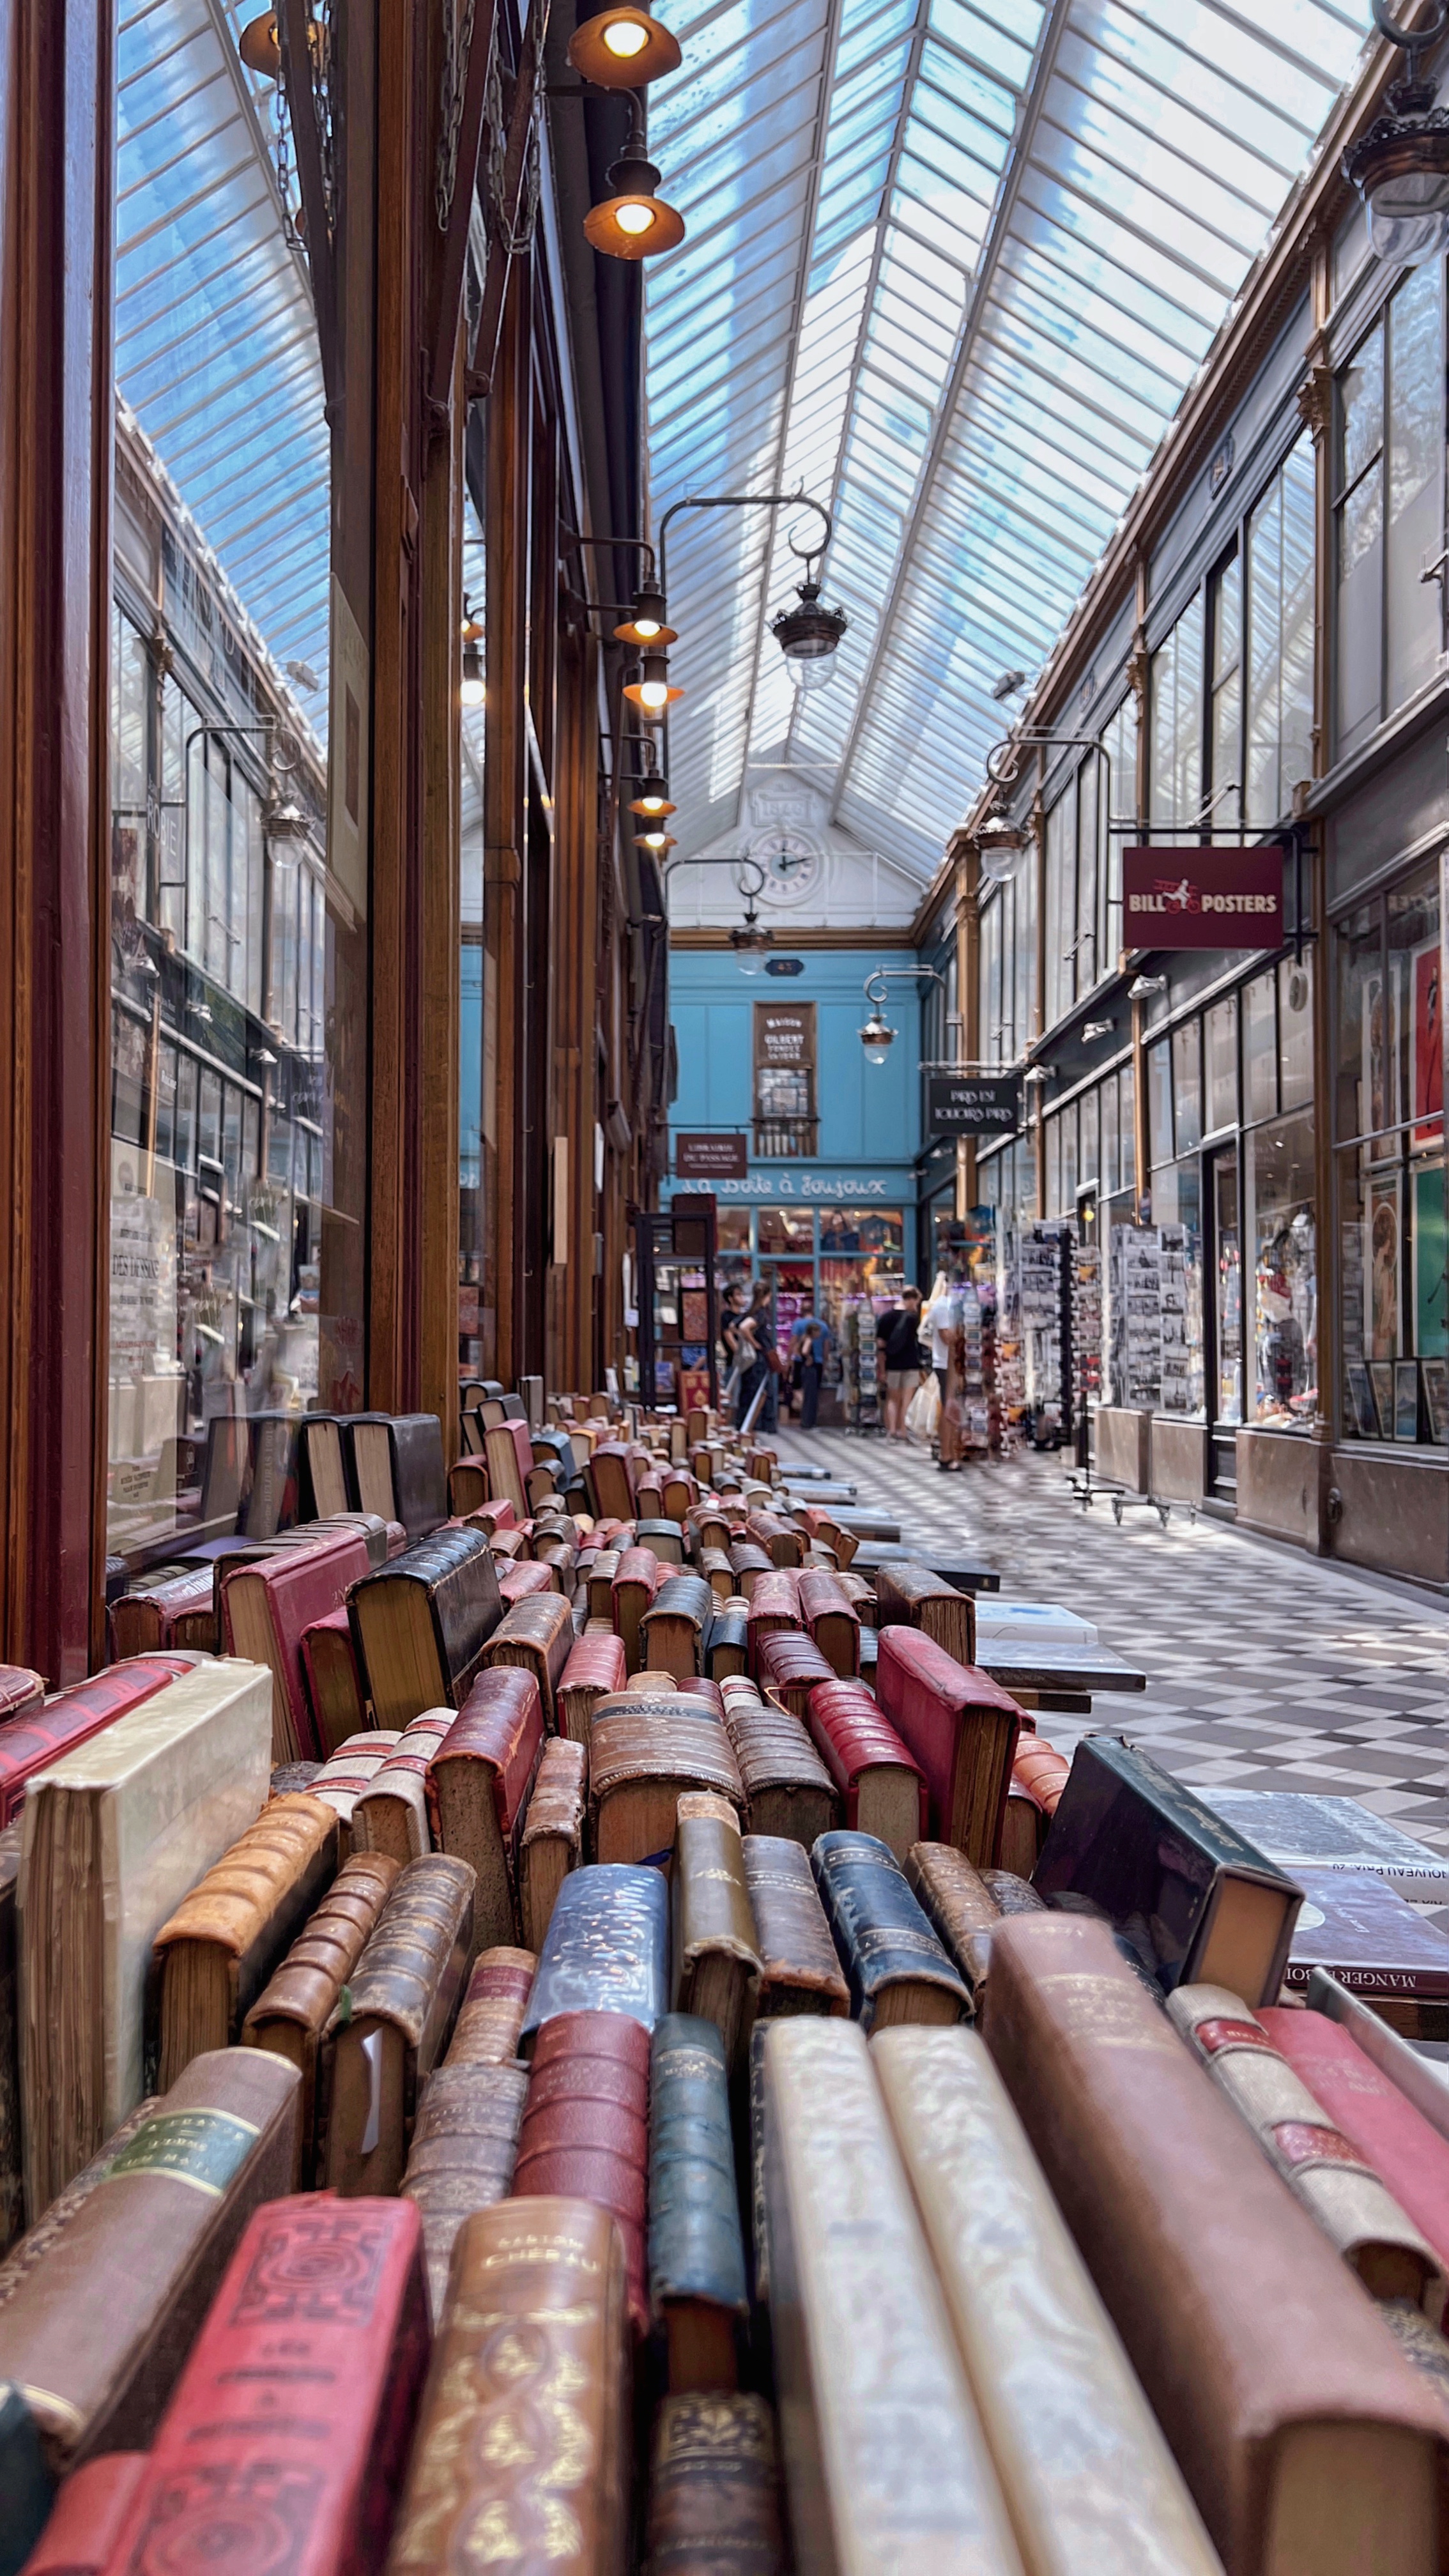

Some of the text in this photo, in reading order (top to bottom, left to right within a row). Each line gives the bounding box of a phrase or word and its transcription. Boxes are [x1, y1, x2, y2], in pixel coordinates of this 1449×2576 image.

[1129, 894, 1277, 914] BILL POSTERS
[764, 1034, 804, 1045] GILBERT
[951, 1089, 977, 1105] PARIS
[935, 1107, 1013, 1123] TOUJOURS PARIS
[699, 1153, 740, 1162] PASSAGE
[779, 1172, 795, 1194] à
[1341, 1971, 1416, 1988] MANGER
